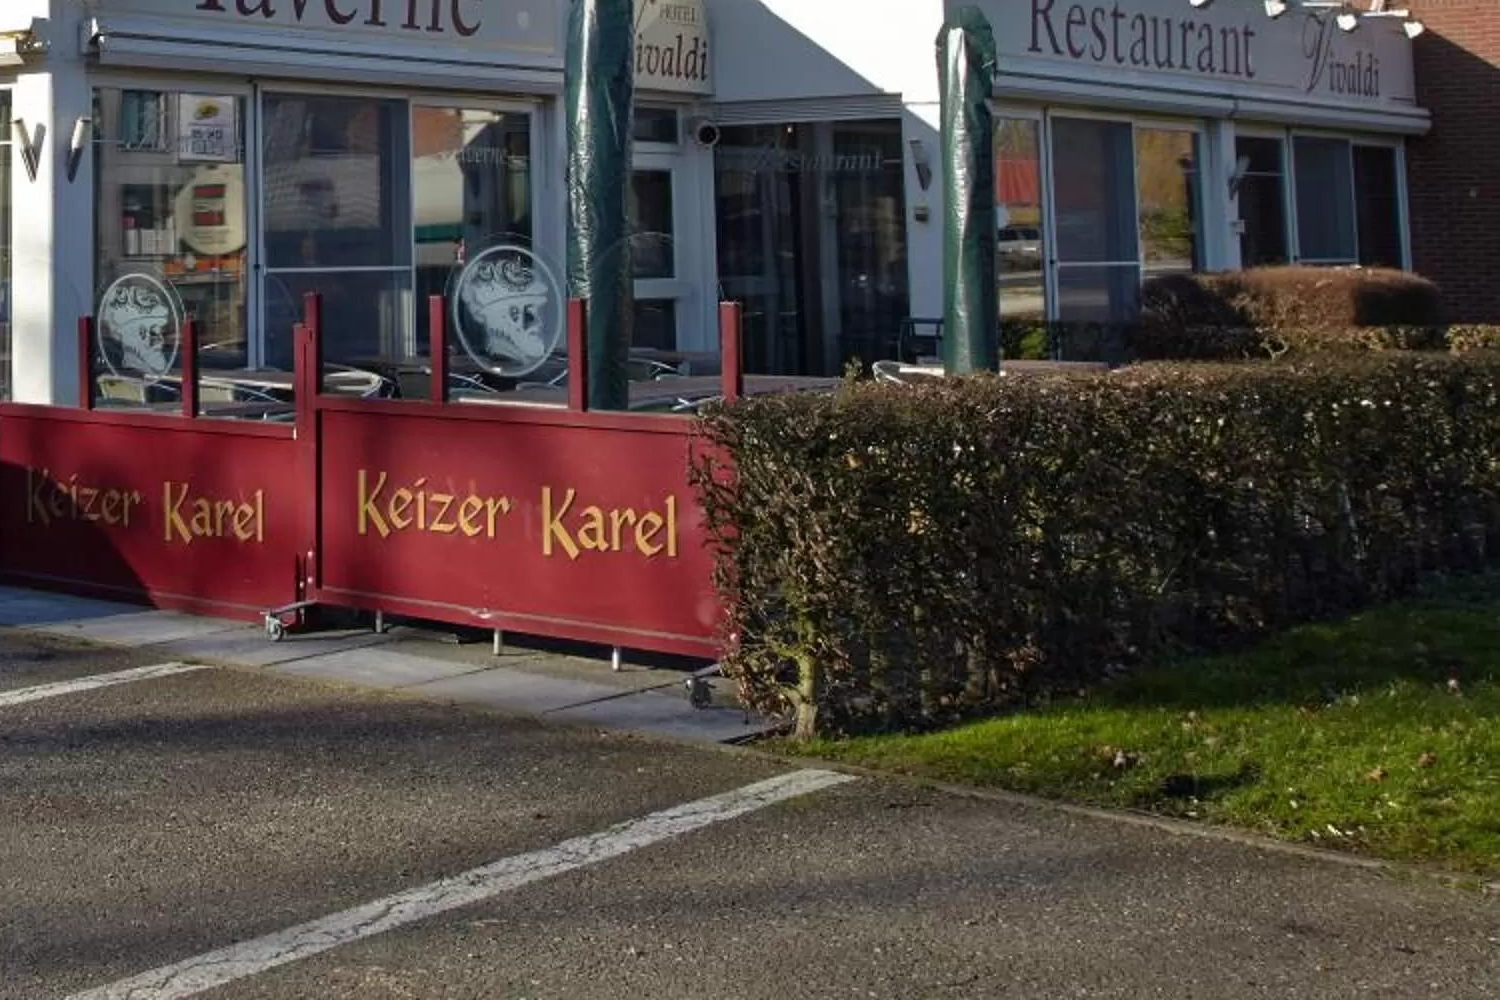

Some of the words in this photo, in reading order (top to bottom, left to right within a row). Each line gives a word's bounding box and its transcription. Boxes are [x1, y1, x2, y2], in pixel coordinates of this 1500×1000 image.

[1302, 8, 1380, 98] Vivaldi
[27, 467, 141, 524] Keizer
[164, 481, 265, 545] Karel
[357, 468, 512, 539] Keizer
[541, 486, 677, 560] Karel
